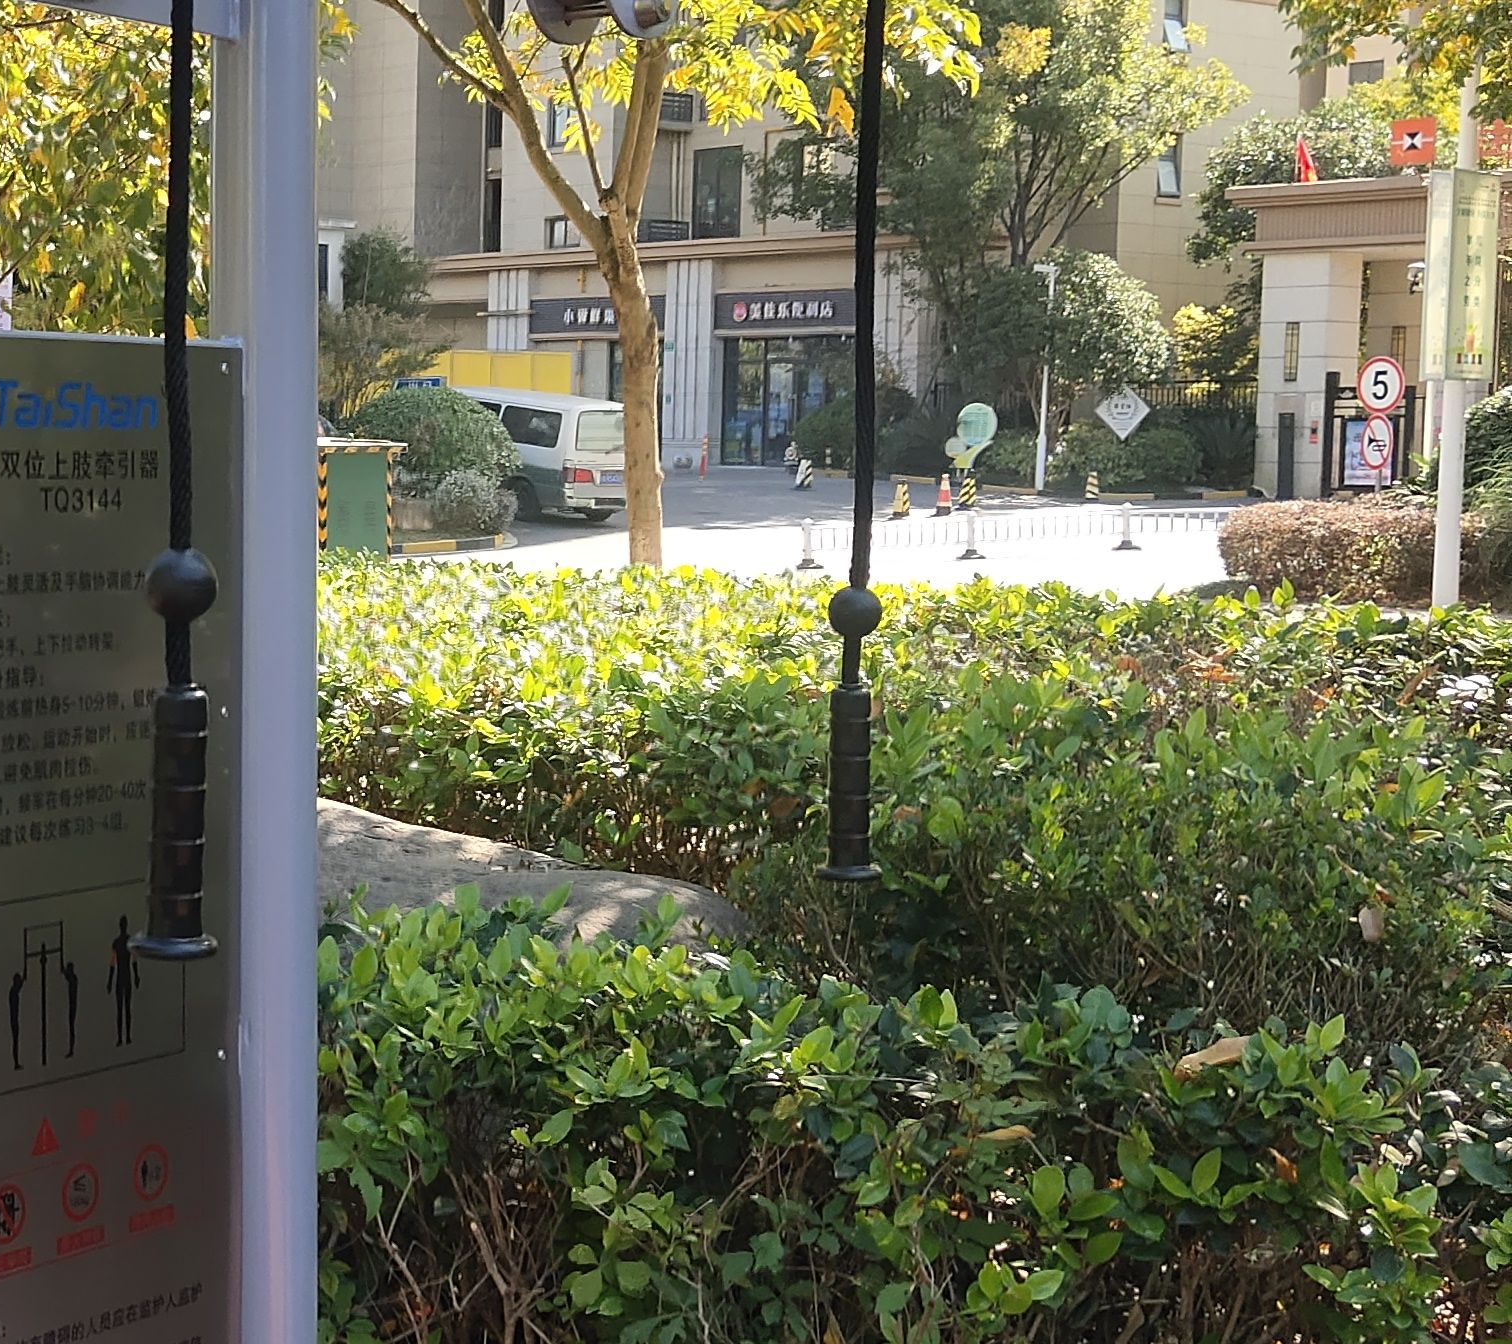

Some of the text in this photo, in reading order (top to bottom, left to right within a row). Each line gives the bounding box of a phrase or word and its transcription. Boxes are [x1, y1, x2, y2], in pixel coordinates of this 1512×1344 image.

[1372, 370, 1388, 401] 5
[0, 449, 159, 481] 双位上肢牵引器
[40, 486, 123, 513] TQ3144
